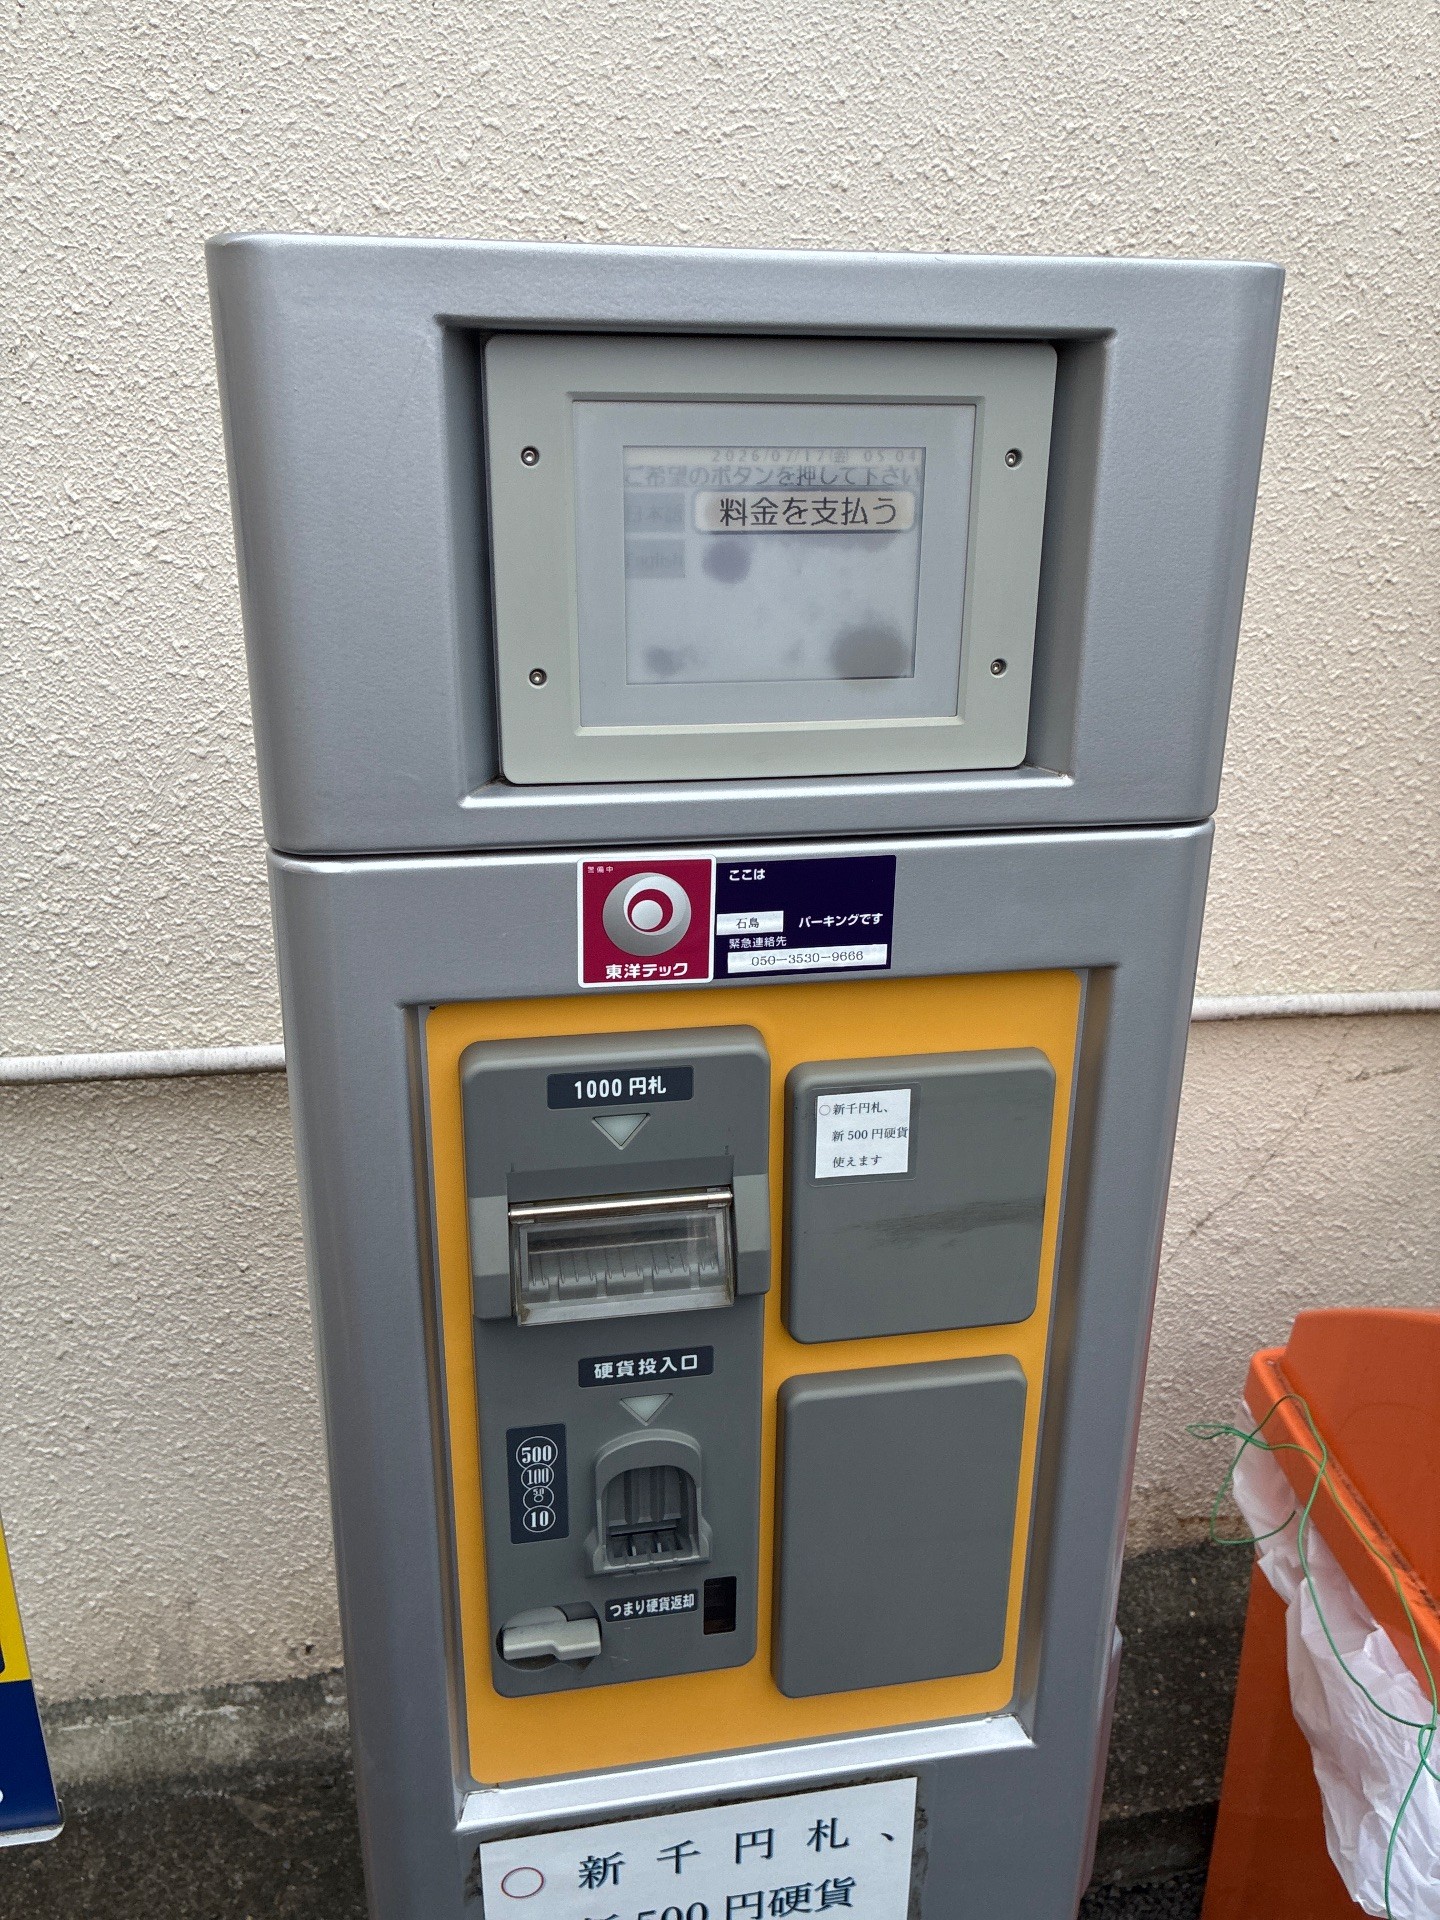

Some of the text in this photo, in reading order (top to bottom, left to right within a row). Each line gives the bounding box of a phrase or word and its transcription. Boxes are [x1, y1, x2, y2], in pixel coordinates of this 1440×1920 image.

[720, 496, 896, 526] 料金を支払う
[728, 868, 766, 882] ここは
[735, 911, 884, 930] 石島 パーキングです
[728, 935, 788, 950] 緊急連絡先
[605, 962, 688, 980] 東洋テック
[832, 1154, 883, 1168] 使えます
[593, 1354, 698, 1380] 硬貨投入口
[521, 1444, 552, 1464] 500
[526, 1467, 550, 1486] 100
[530, 1510, 549, 1528] 10
[609, 1593, 695, 1617] つまり硬貨返却
